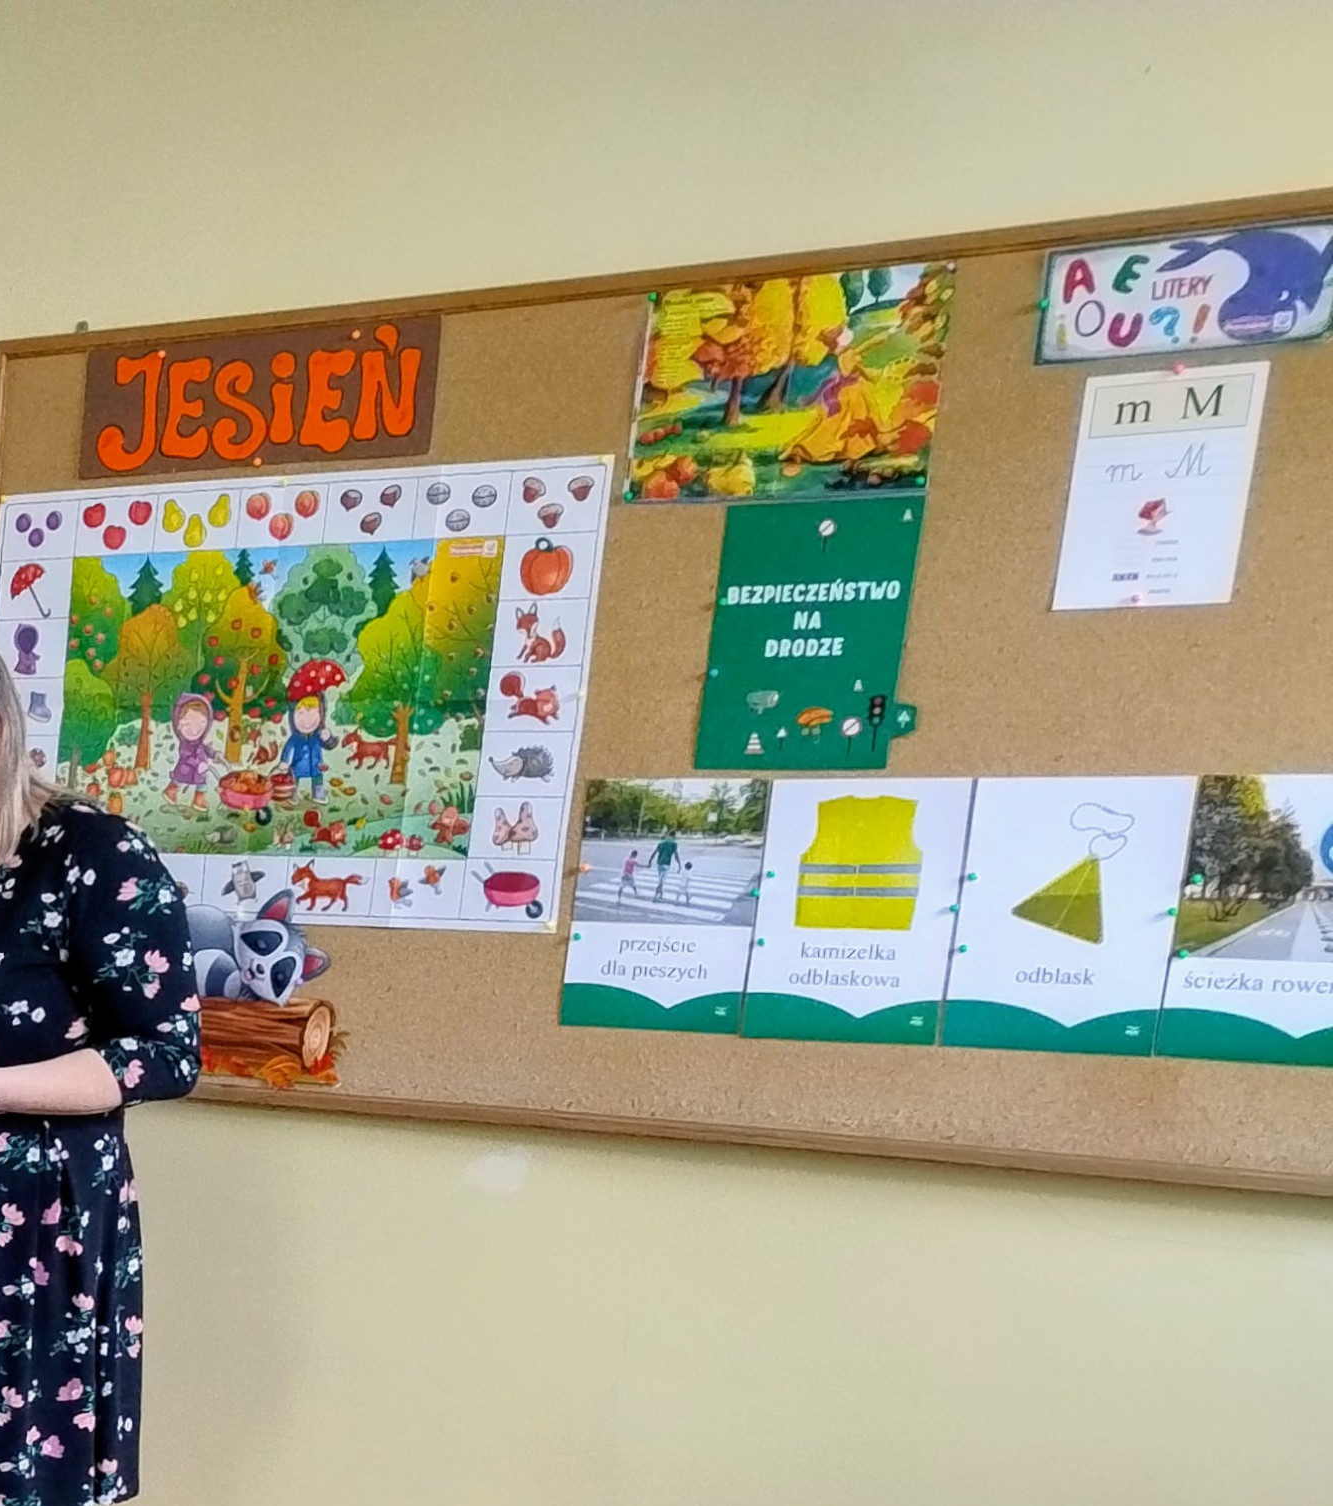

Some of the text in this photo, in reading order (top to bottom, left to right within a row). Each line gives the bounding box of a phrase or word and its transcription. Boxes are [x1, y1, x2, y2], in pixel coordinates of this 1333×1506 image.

[1063, 254, 1213, 303] A E LITERY
[1114, 383, 1226, 426] m M
[727, 578, 901, 605] BEZPIECZEŃSTWO
[793, 610, 822, 630] NA
[764, 637, 845, 658] DRODZE
[619, 935, 697, 955] przejście
[800, 942, 896, 961] kamizelka
[600, 960, 708, 982] dla pieszych
[788, 968, 900, 988] odblaskowa
[1015, 967, 1095, 986] odblask
[1183, 971, 1263, 992] ścieżka
